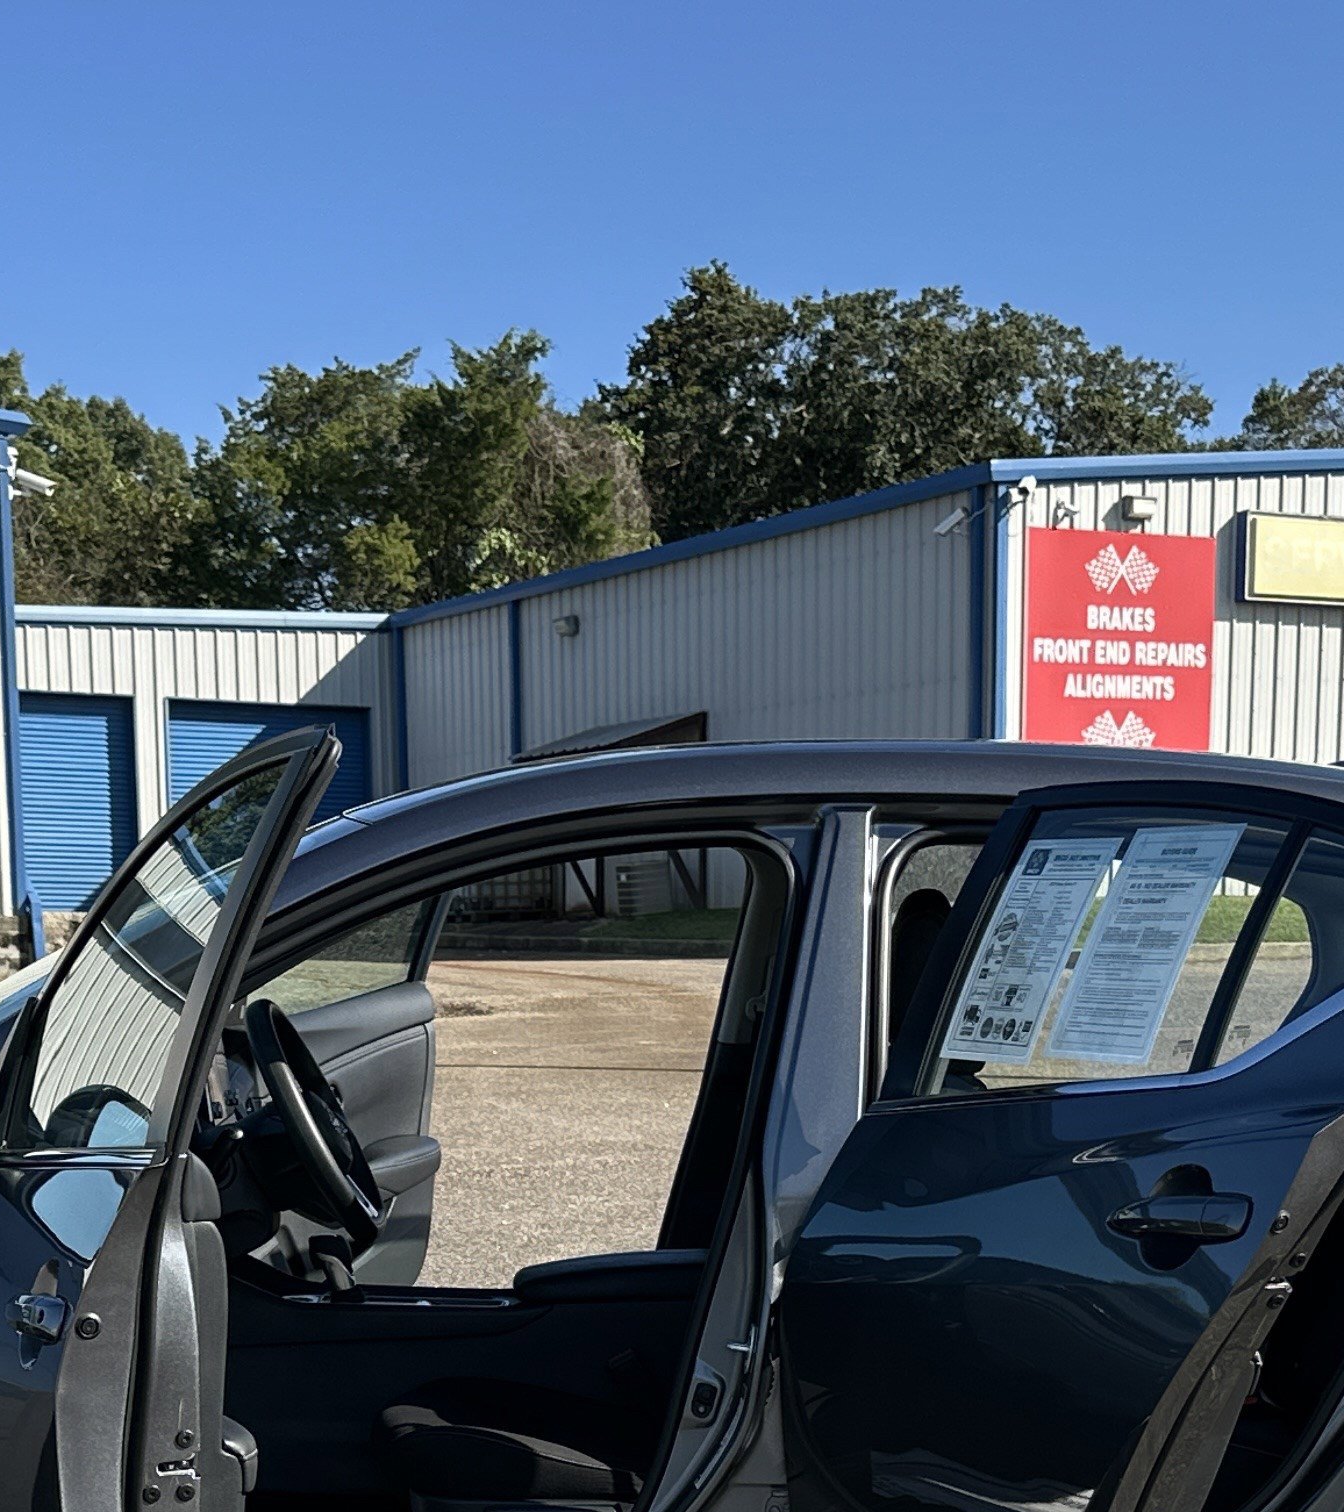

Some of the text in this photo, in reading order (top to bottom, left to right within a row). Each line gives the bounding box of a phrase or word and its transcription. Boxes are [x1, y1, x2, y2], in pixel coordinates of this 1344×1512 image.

[1086, 604, 1156, 633] BRAKES
[1033, 636, 1207, 669] FRONT END REPAIRS
[1063, 673, 1175, 701] ALIGNMENTS
